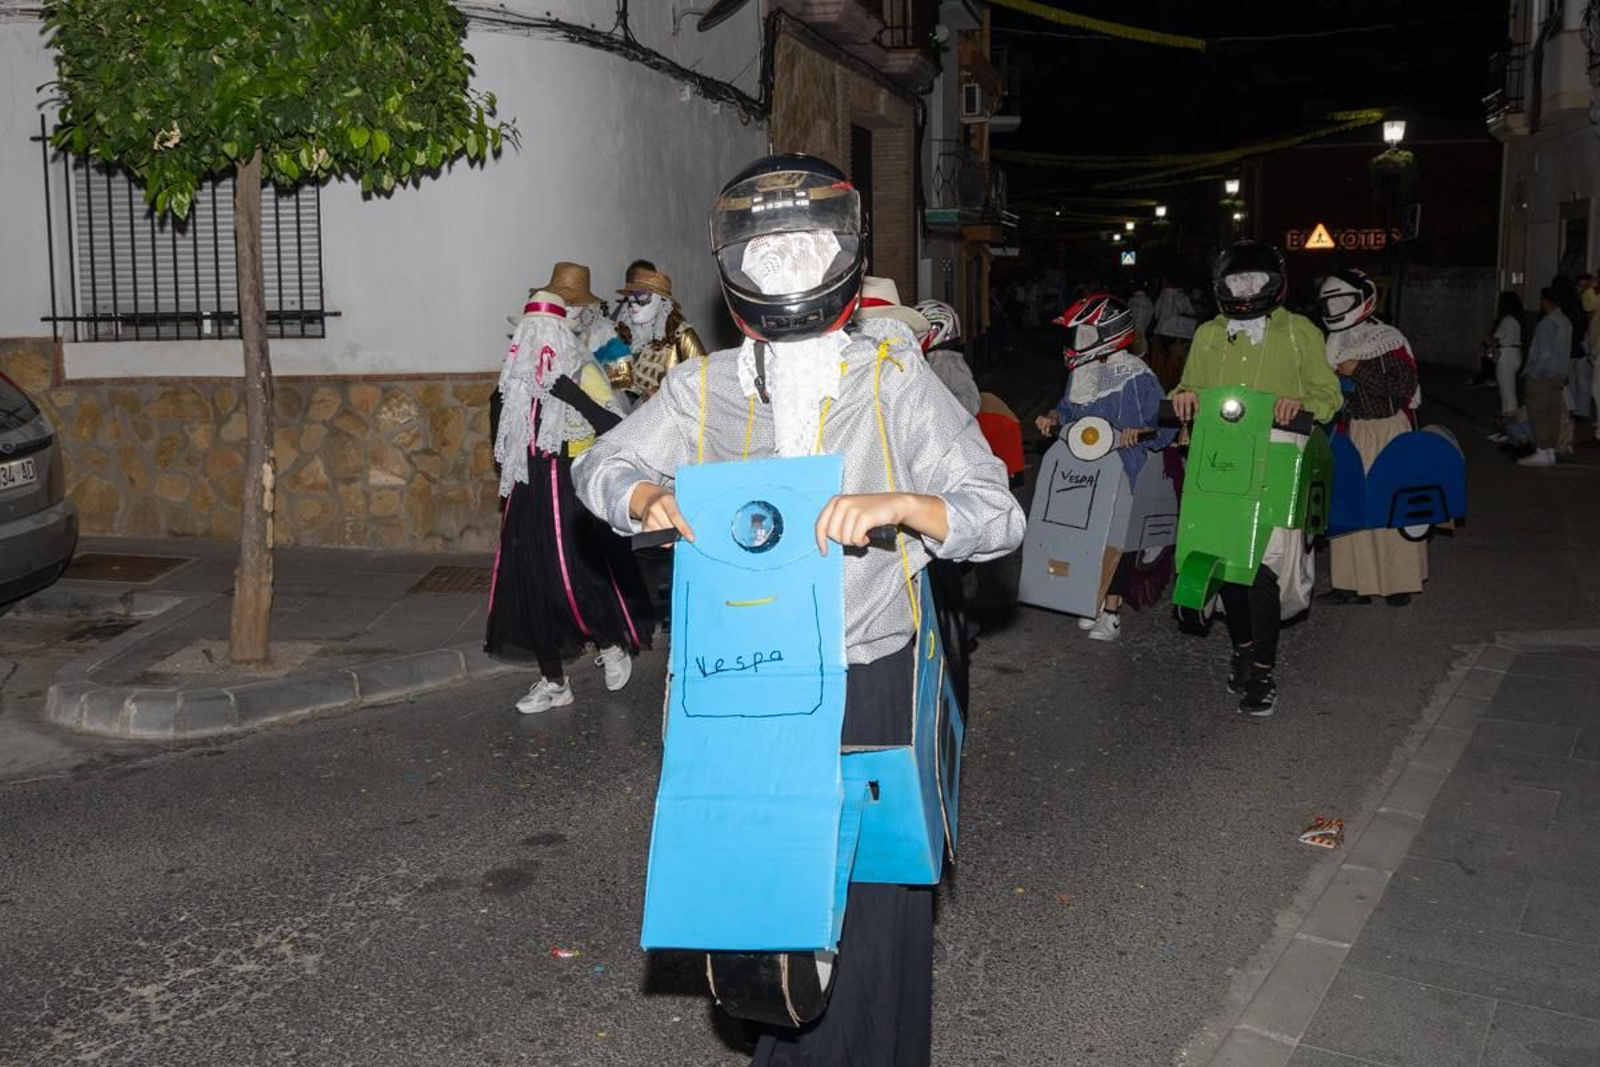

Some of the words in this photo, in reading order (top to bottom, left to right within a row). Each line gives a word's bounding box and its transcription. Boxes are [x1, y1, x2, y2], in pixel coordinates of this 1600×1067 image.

[0, 464, 16, 487] 34
[1061, 469, 1095, 487] VESPA
[695, 650, 784, 677] Vespa
